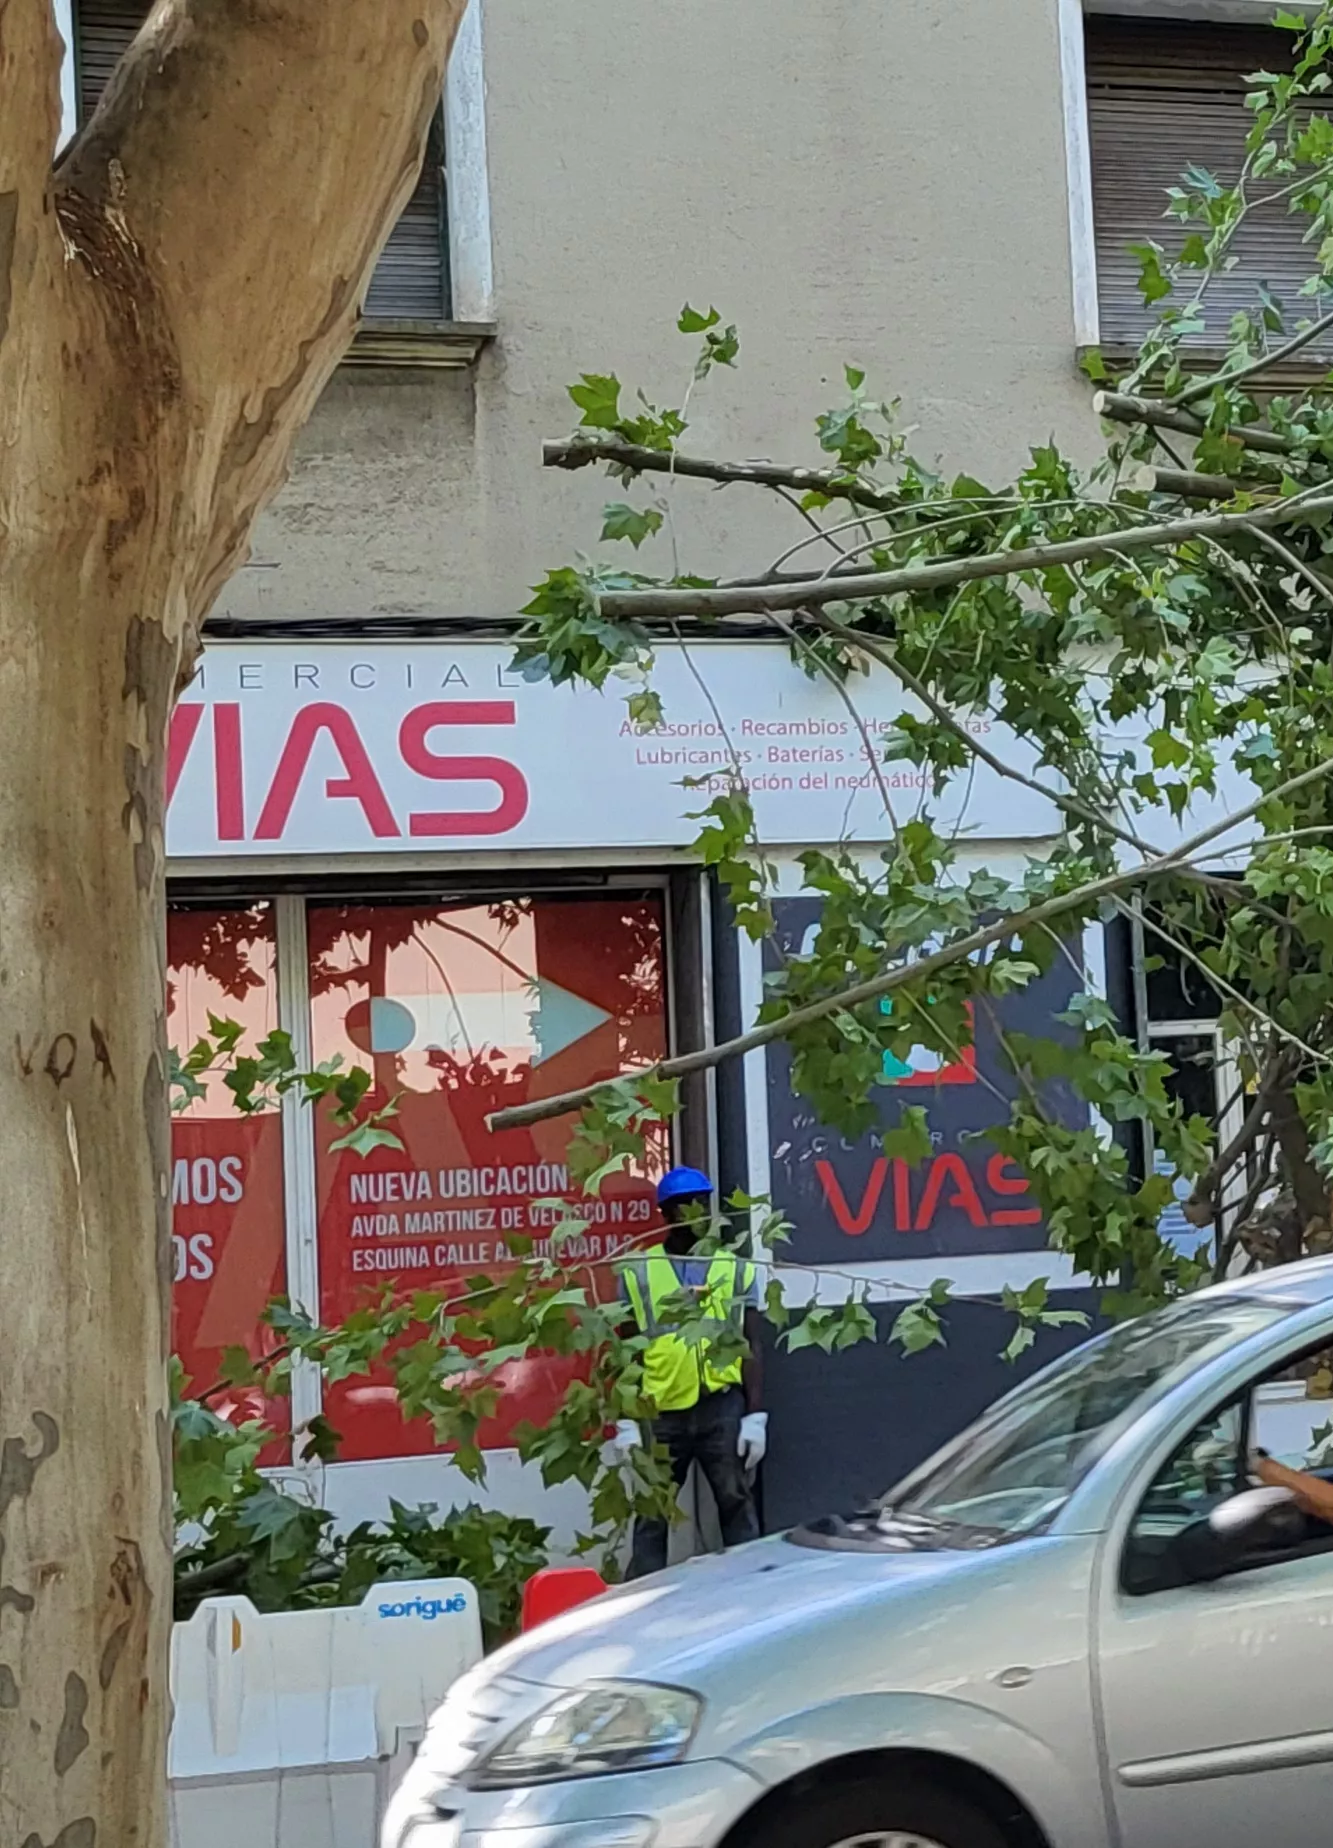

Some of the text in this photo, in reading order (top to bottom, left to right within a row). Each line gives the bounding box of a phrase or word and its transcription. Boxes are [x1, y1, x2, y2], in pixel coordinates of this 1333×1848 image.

[619, 719, 725, 738] Acesorios
[741, 718, 849, 736] Recambios
[635, 747, 752, 765] Lubricantes
[767, 744, 845, 764] Baterías
[799, 771, 828, 789] del
[351, 1171, 433, 1203] NUEVA
[815, 1152, 1043, 1236] VIAS
[351, 1199, 651, 1239] AVDA MARTINEZ DE VELSCO N 29
[352, 1246, 431, 1272] ESQUINA
[434, 1242, 491, 1267] CALLE
